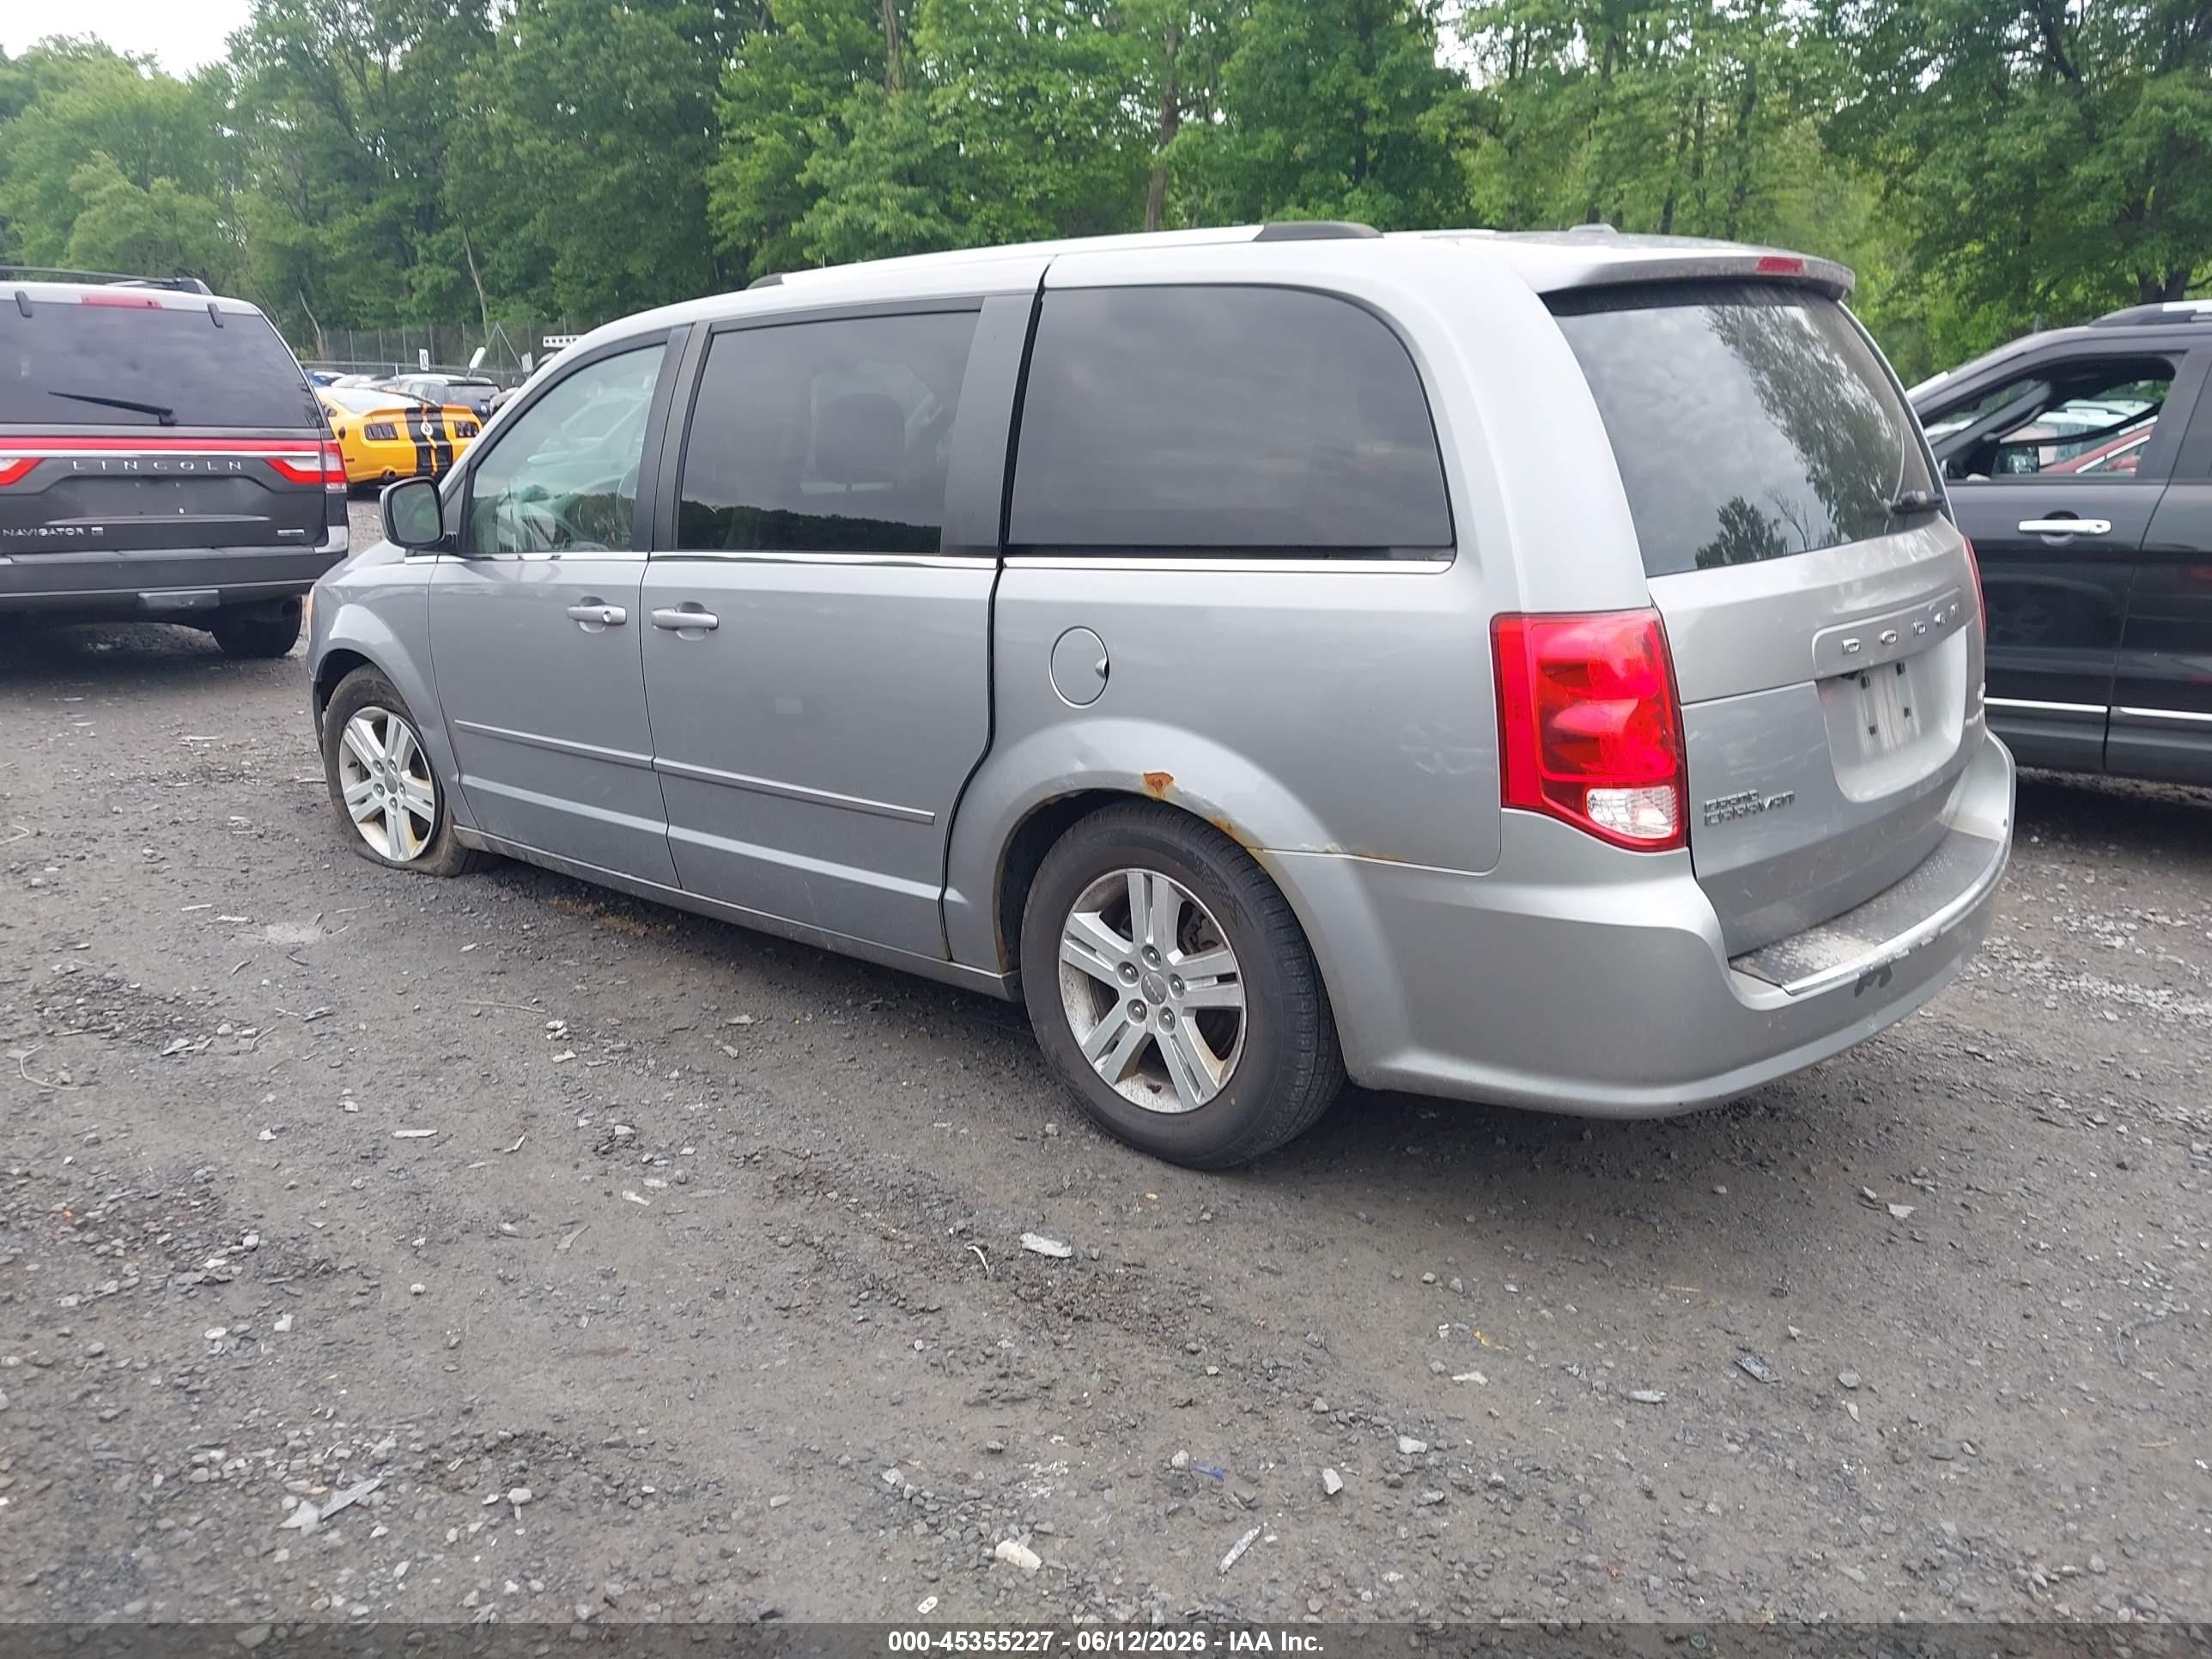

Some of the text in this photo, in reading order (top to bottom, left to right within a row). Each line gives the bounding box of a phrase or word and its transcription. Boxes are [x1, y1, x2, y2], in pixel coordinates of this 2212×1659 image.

[72, 460, 241, 471] LINCOLN
[2, 527, 84, 537] NAVIGATOR
[1842, 602, 1960, 656] DODGE
